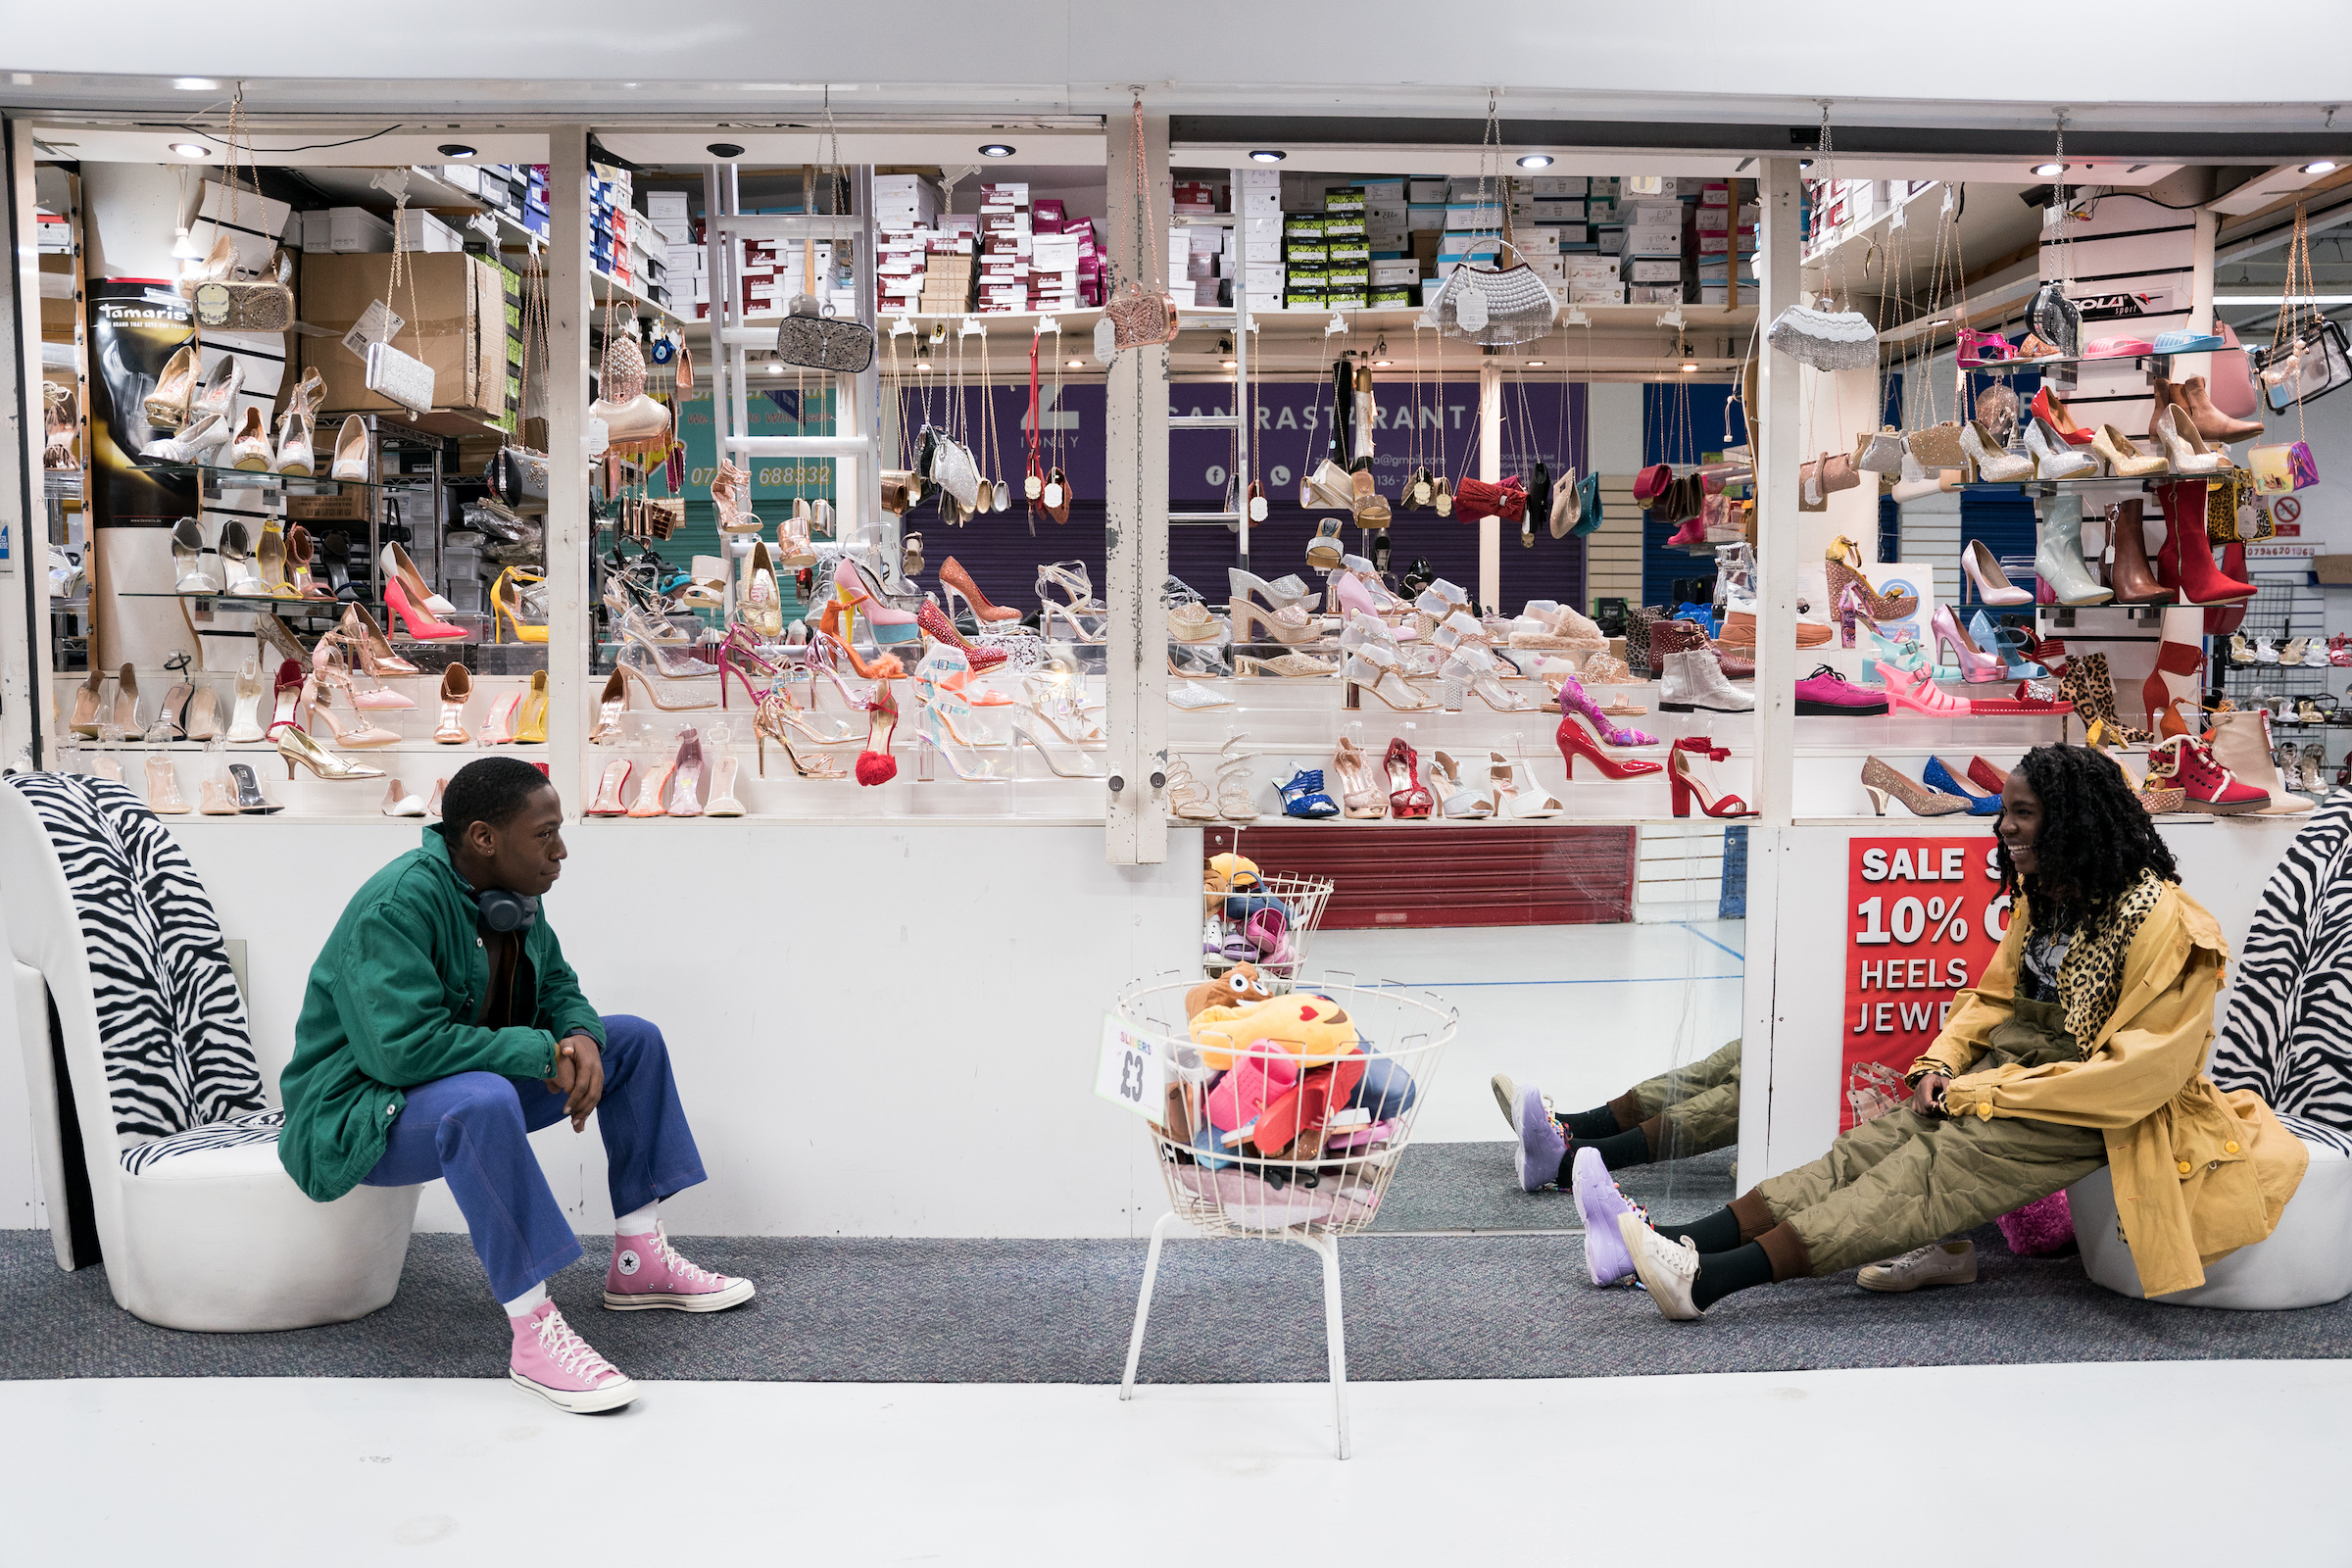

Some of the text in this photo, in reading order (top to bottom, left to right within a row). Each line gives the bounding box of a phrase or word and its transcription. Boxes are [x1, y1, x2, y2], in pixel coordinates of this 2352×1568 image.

[2115, 305, 2137, 316] sport
[688, 414, 709, 424] We
[1861, 847, 1965, 881] SALE
[1855, 896, 1969, 944] 10%
[1861, 957, 1969, 990] HEELS
[1120, 1031, 1152, 1055] SLIDERS
[1120, 1051, 1144, 1102] £3
